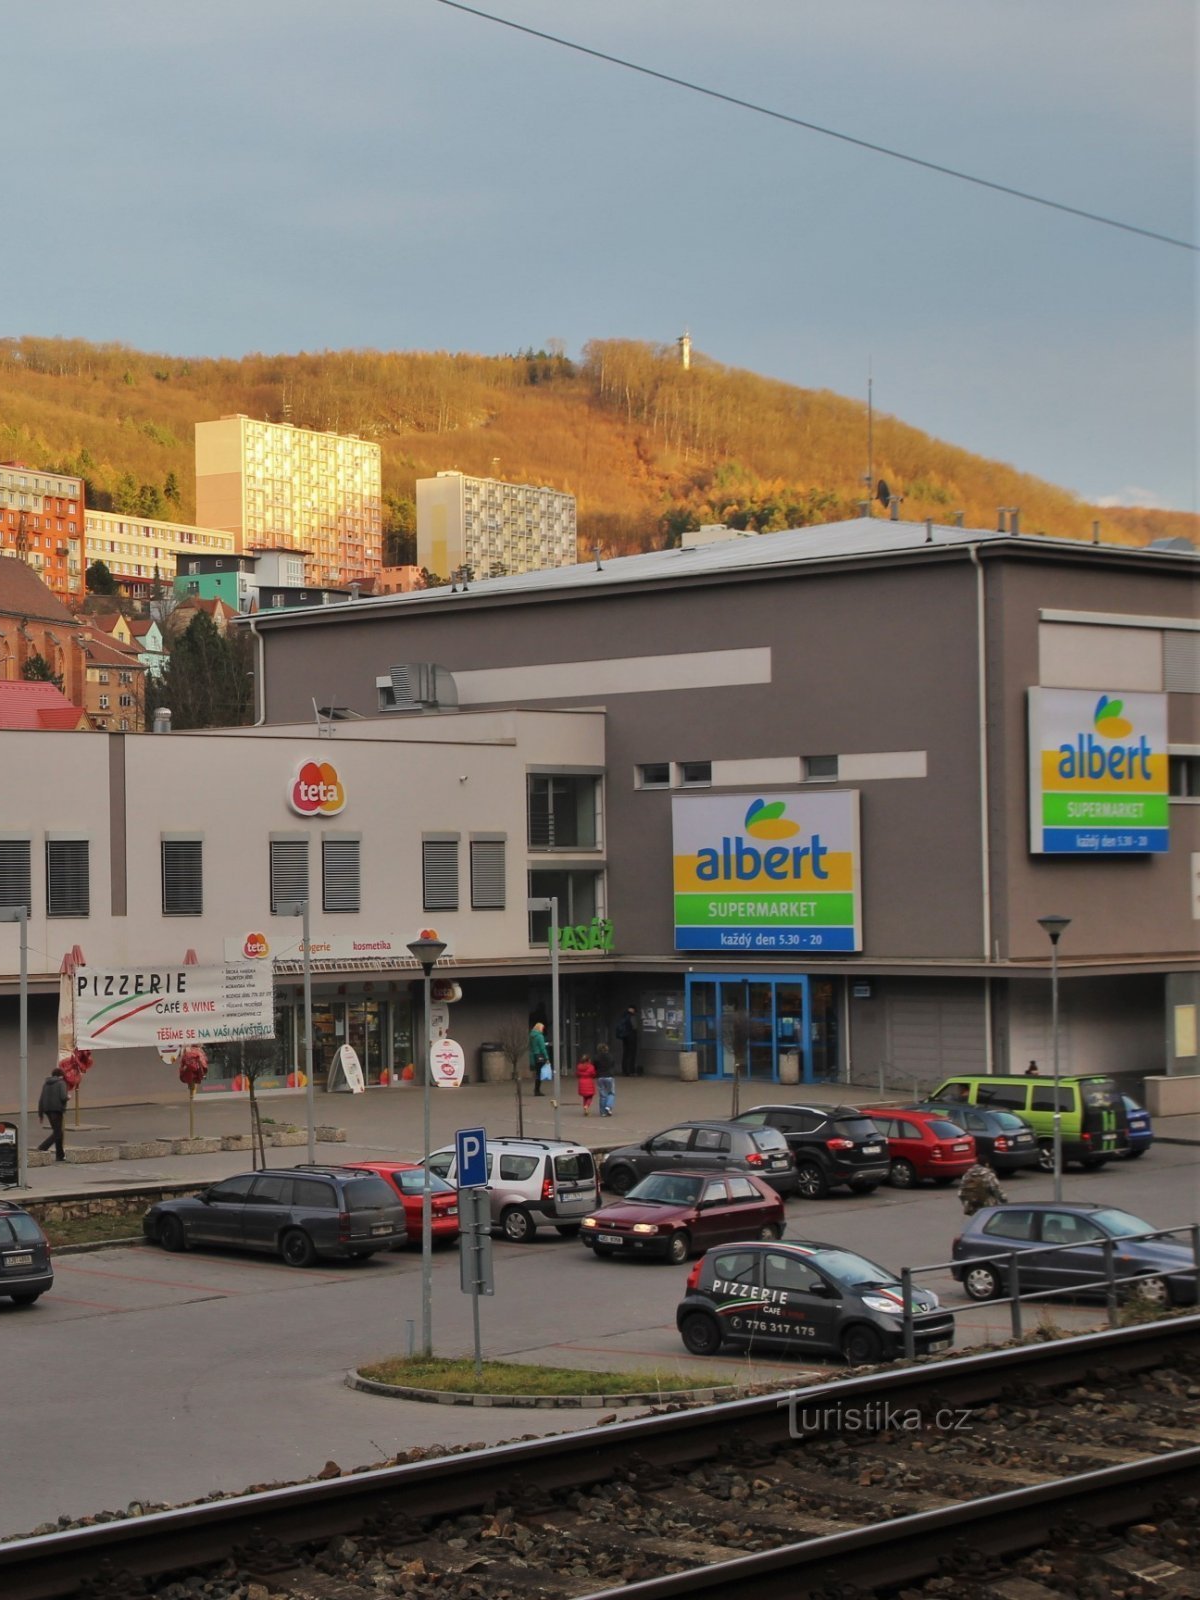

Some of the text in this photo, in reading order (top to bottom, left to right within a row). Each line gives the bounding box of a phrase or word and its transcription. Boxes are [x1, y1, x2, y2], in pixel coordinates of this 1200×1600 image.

[1058, 733, 1152, 781] albert
[299, 781, 339, 802] teta
[1067, 802, 1144, 818] SUPERMARKET
[696, 834, 828, 881] albert
[708, 901, 817, 918] SUPERMARKET
[247, 942, 266, 952] teta
[298, 940, 392, 954] dogerie kosmetika
[720, 932, 751, 949] každý
[755, 933, 775, 945] den
[779, 934, 800, 945] 5.30
[810, 934, 823, 945] 20
[77, 973, 186, 997] PIZZERIE
[155, 1001, 181, 1014] CAFÉ
[183, 1001, 189, 1013] &
[191, 1001, 216, 1012] WINE
[157, 1027, 183, 1041] TĚŠÍME
[186, 1029, 196, 1039] SE
[198, 1029, 210, 1038] NA
[214, 1025, 230, 1037] VAŠI
[463, 1136, 480, 1170] P
[712, 1279, 788, 1305] PIZZERIE
[746, 1320, 815, 1336] 776 317 175
